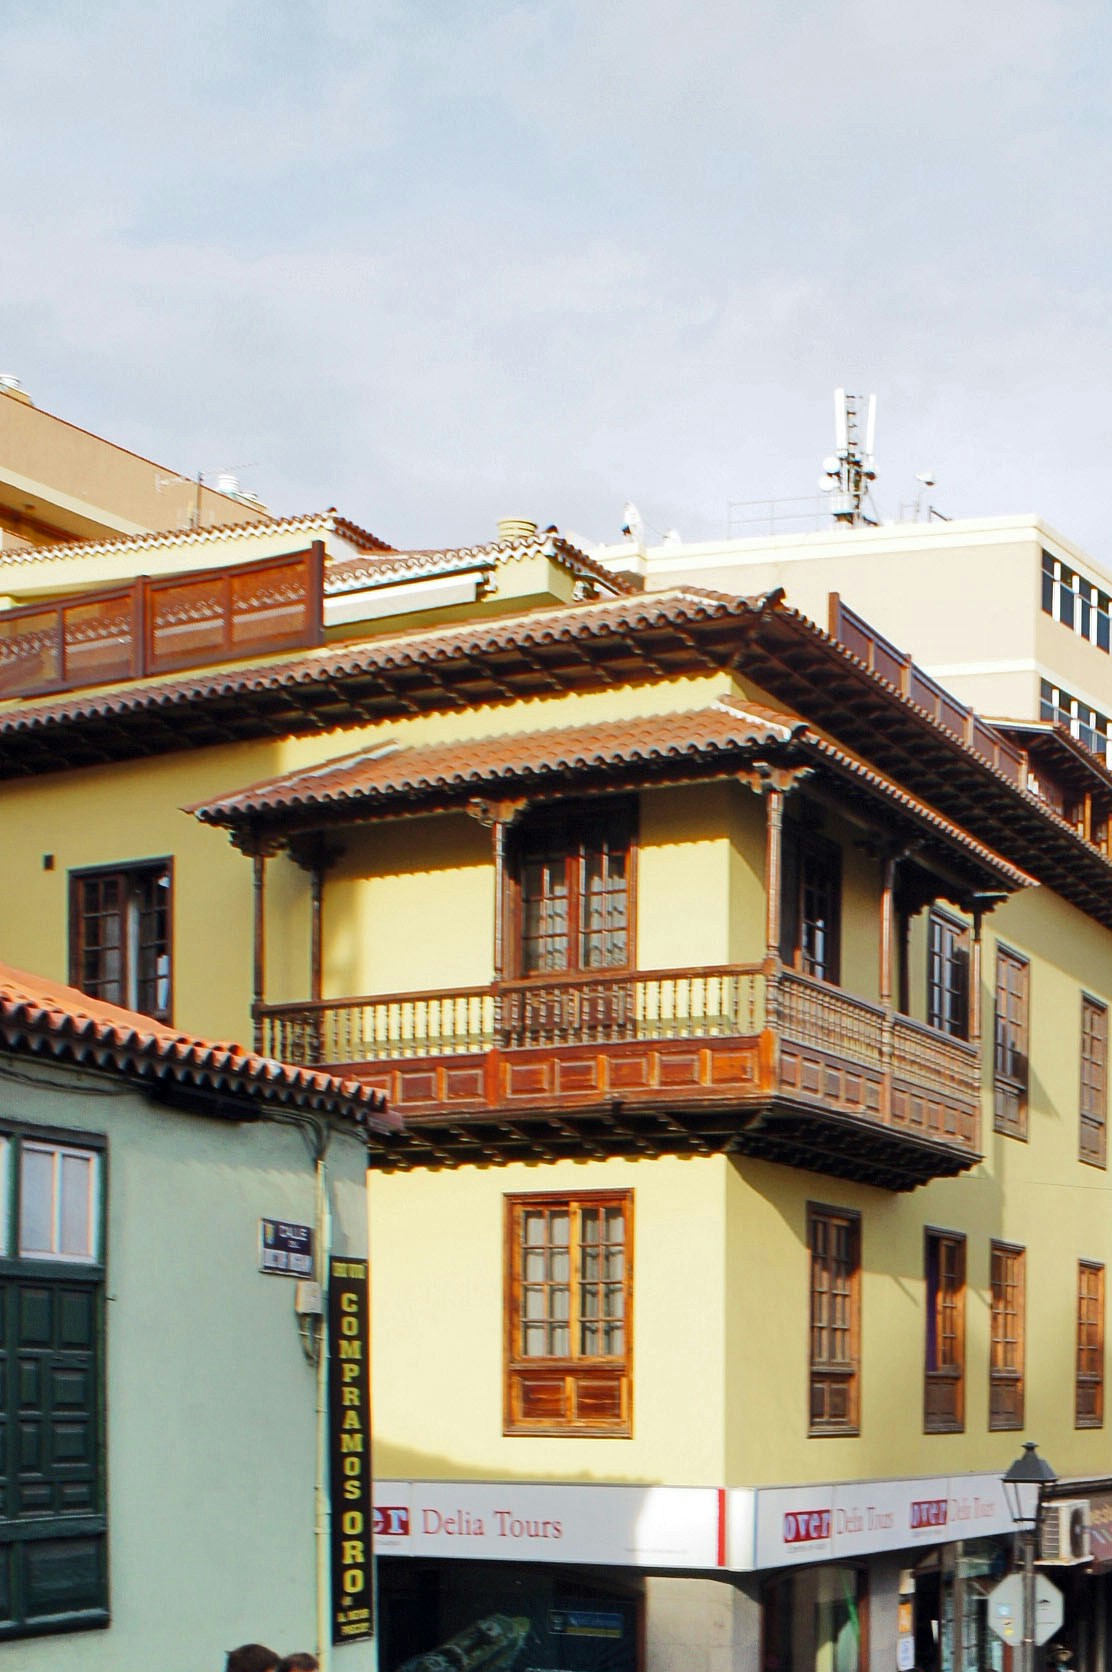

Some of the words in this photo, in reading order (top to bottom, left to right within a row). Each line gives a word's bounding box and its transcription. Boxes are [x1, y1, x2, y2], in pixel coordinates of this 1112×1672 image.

[338, 1292, 364, 1501] COMPRAMOS
[421, 1509, 485, 1536] Delia
[493, 1510, 564, 1539] Tours
[784, 1512, 831, 1540] over
[912, 1501, 947, 1528] over
[342, 1510, 364, 1593] ORO
